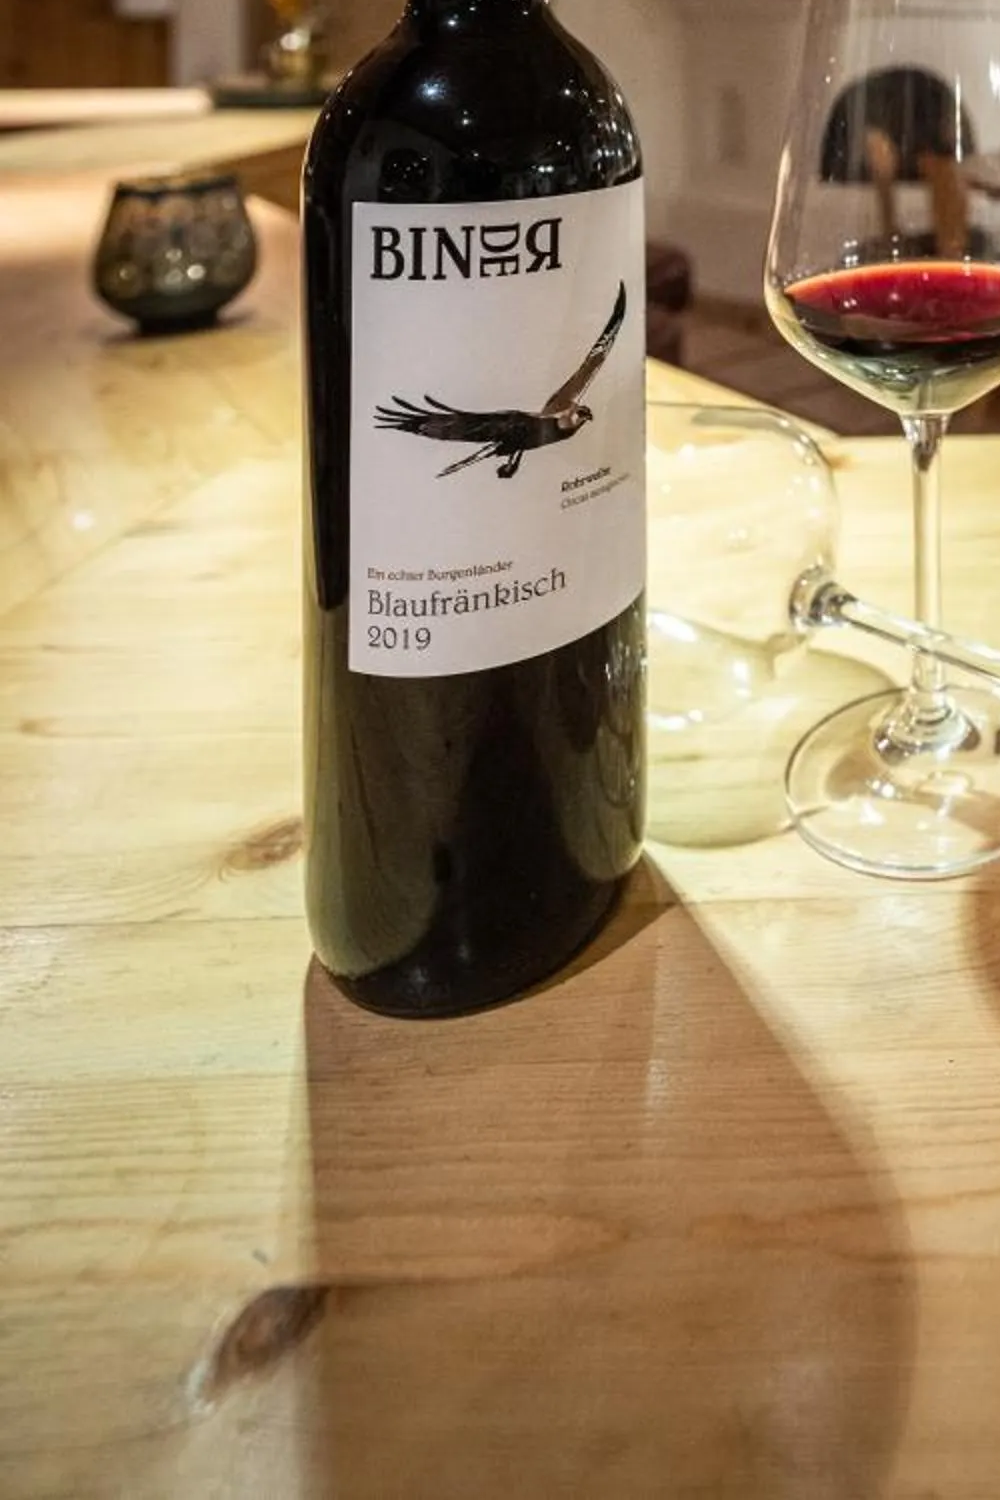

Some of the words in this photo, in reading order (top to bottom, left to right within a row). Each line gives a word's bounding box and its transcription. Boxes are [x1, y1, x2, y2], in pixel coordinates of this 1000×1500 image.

[370, 217, 563, 281] BINDER
[427, 559, 514, 582] Burgenländer
[367, 567, 567, 618] Blaufränkisch
[367, 625, 431, 650] 2019
